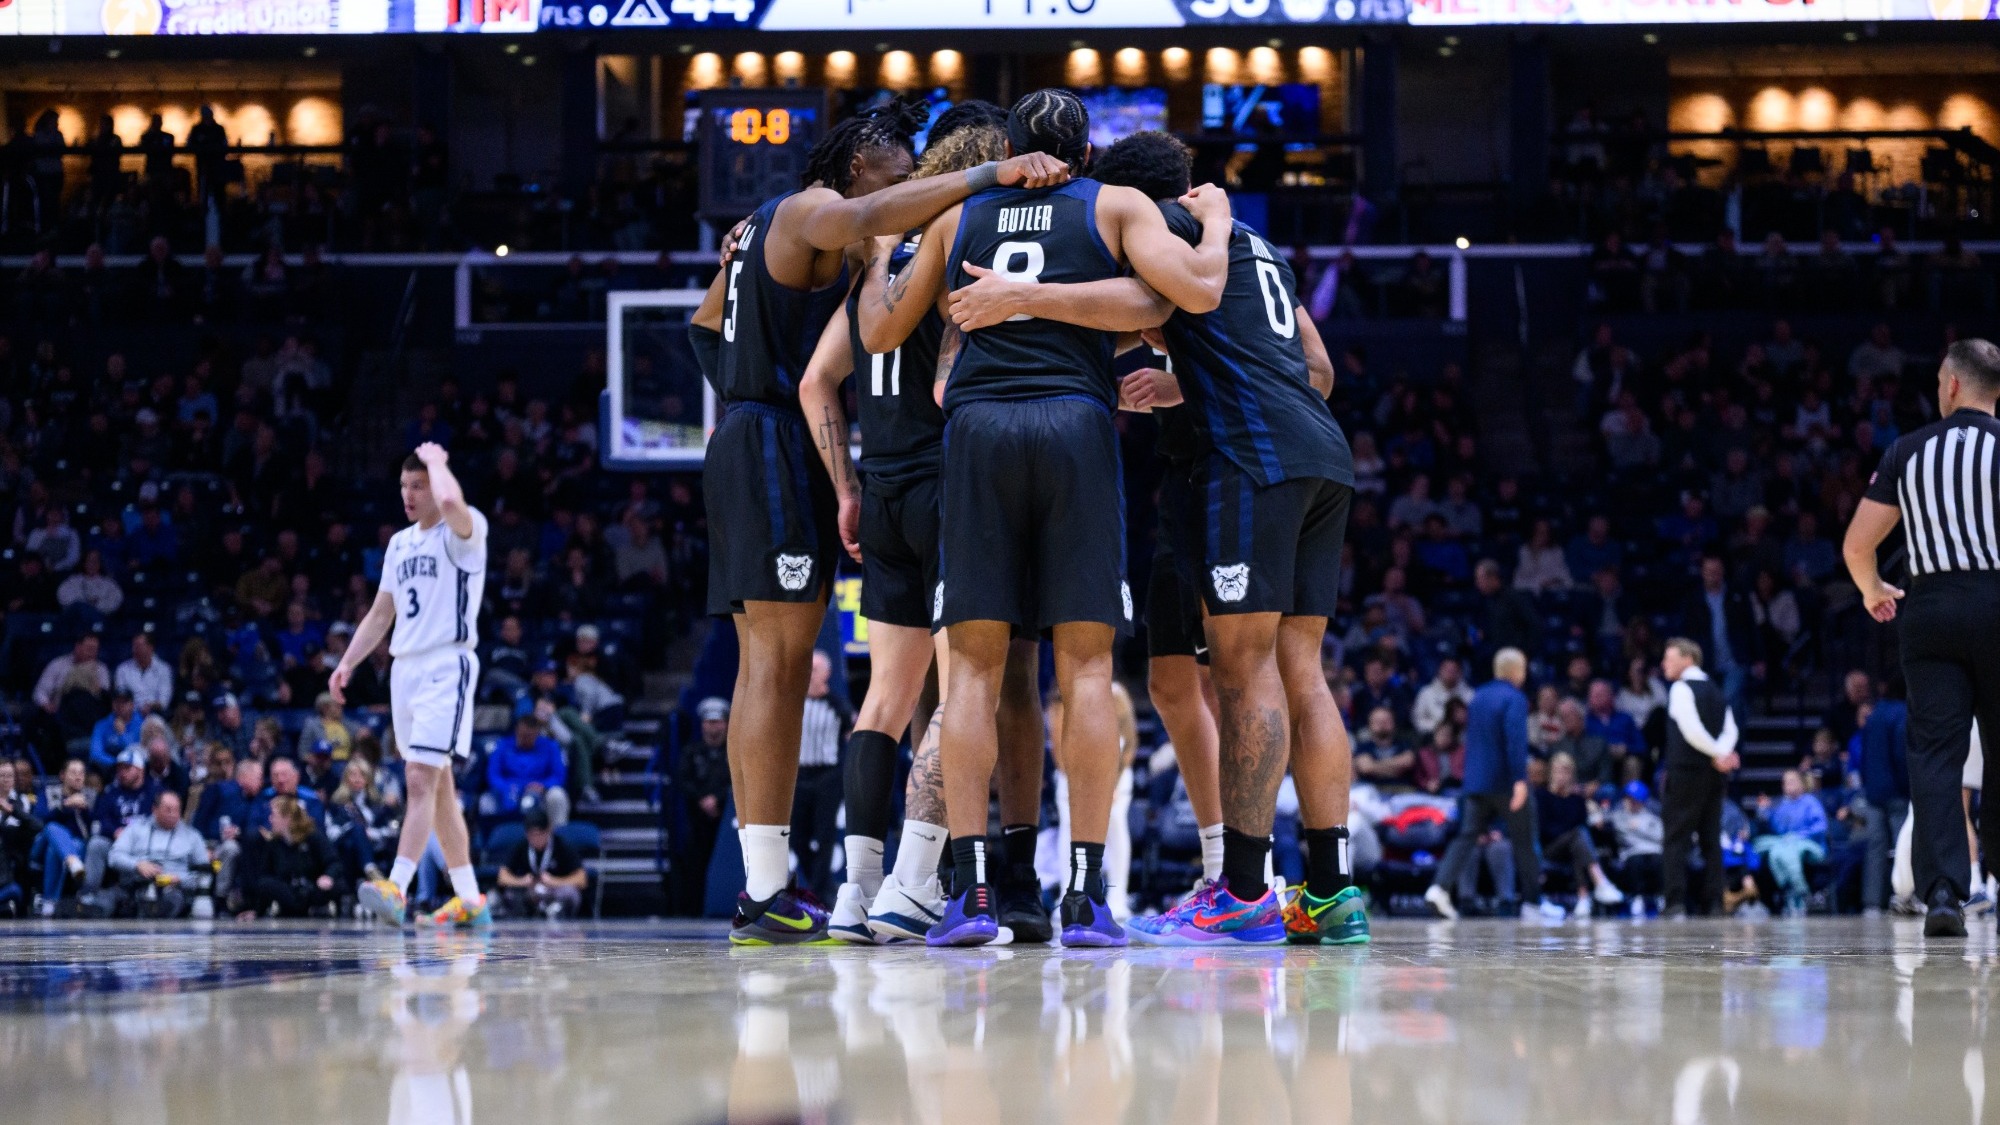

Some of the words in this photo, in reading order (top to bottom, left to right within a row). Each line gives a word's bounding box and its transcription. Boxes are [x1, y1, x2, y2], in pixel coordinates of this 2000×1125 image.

[254, 1, 331, 31] Union
[541, 6, 584, 26] FLS
[997, 204, 1053, 233] BUTLER
[723, 260, 744, 343] 5
[1255, 259, 1295, 339] 0
[406, 586, 420, 619] 3
